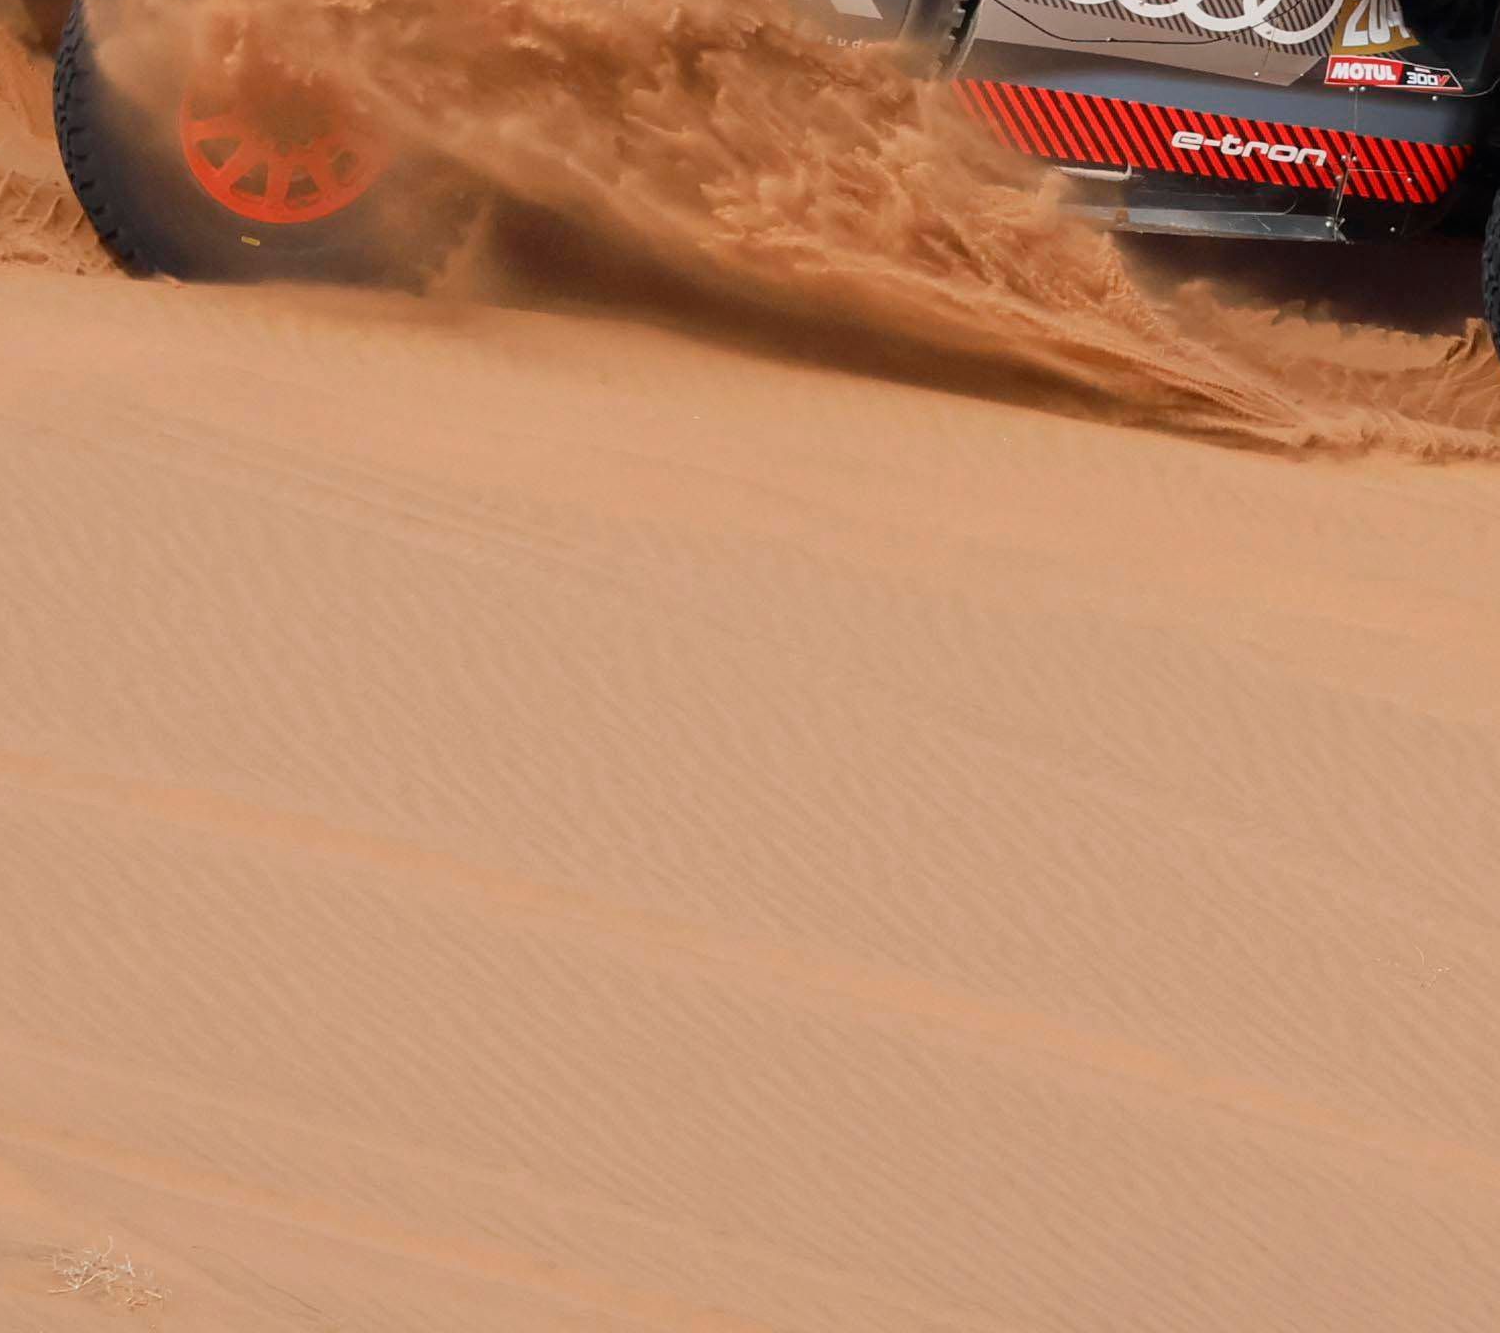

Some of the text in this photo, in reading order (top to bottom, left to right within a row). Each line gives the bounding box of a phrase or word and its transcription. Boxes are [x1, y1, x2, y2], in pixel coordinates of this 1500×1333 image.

[1330, 62, 1398, 81] MOTUL
[1405, 71, 1451, 87] 300V
[1171, 131, 1328, 167] e-tron
